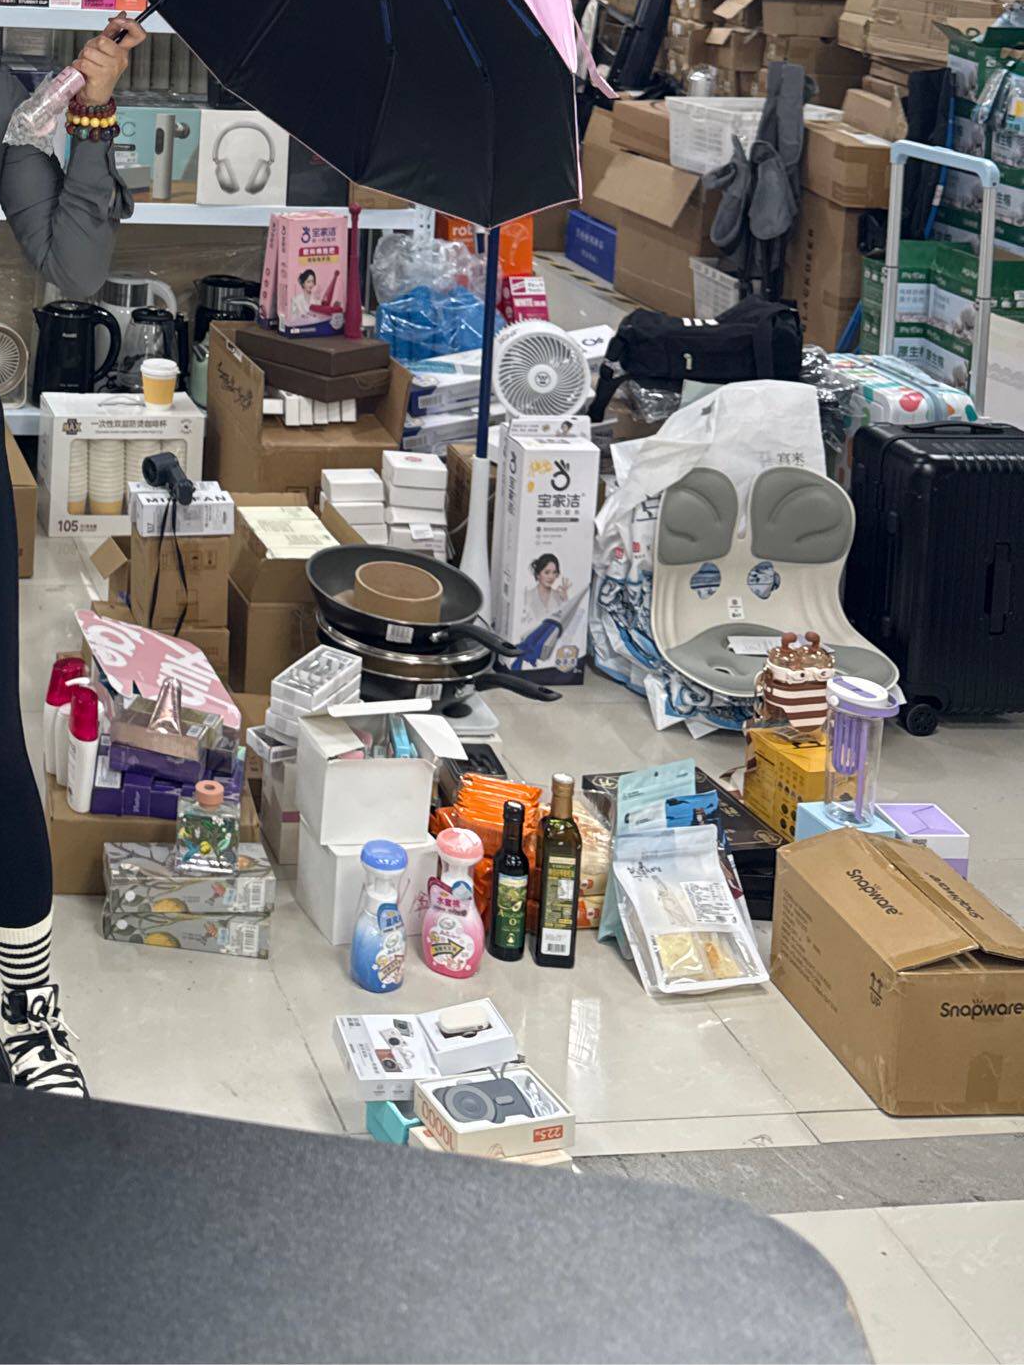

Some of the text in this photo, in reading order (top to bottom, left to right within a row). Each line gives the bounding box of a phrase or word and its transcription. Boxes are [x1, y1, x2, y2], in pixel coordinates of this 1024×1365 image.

[537, 493, 580, 508] 宝家洁
[58, 520, 79, 533] 105
[846, 868, 898, 916] Snapware
[929, 873, 985, 920] Snapware
[940, 1000, 1024, 1020] Snapware
